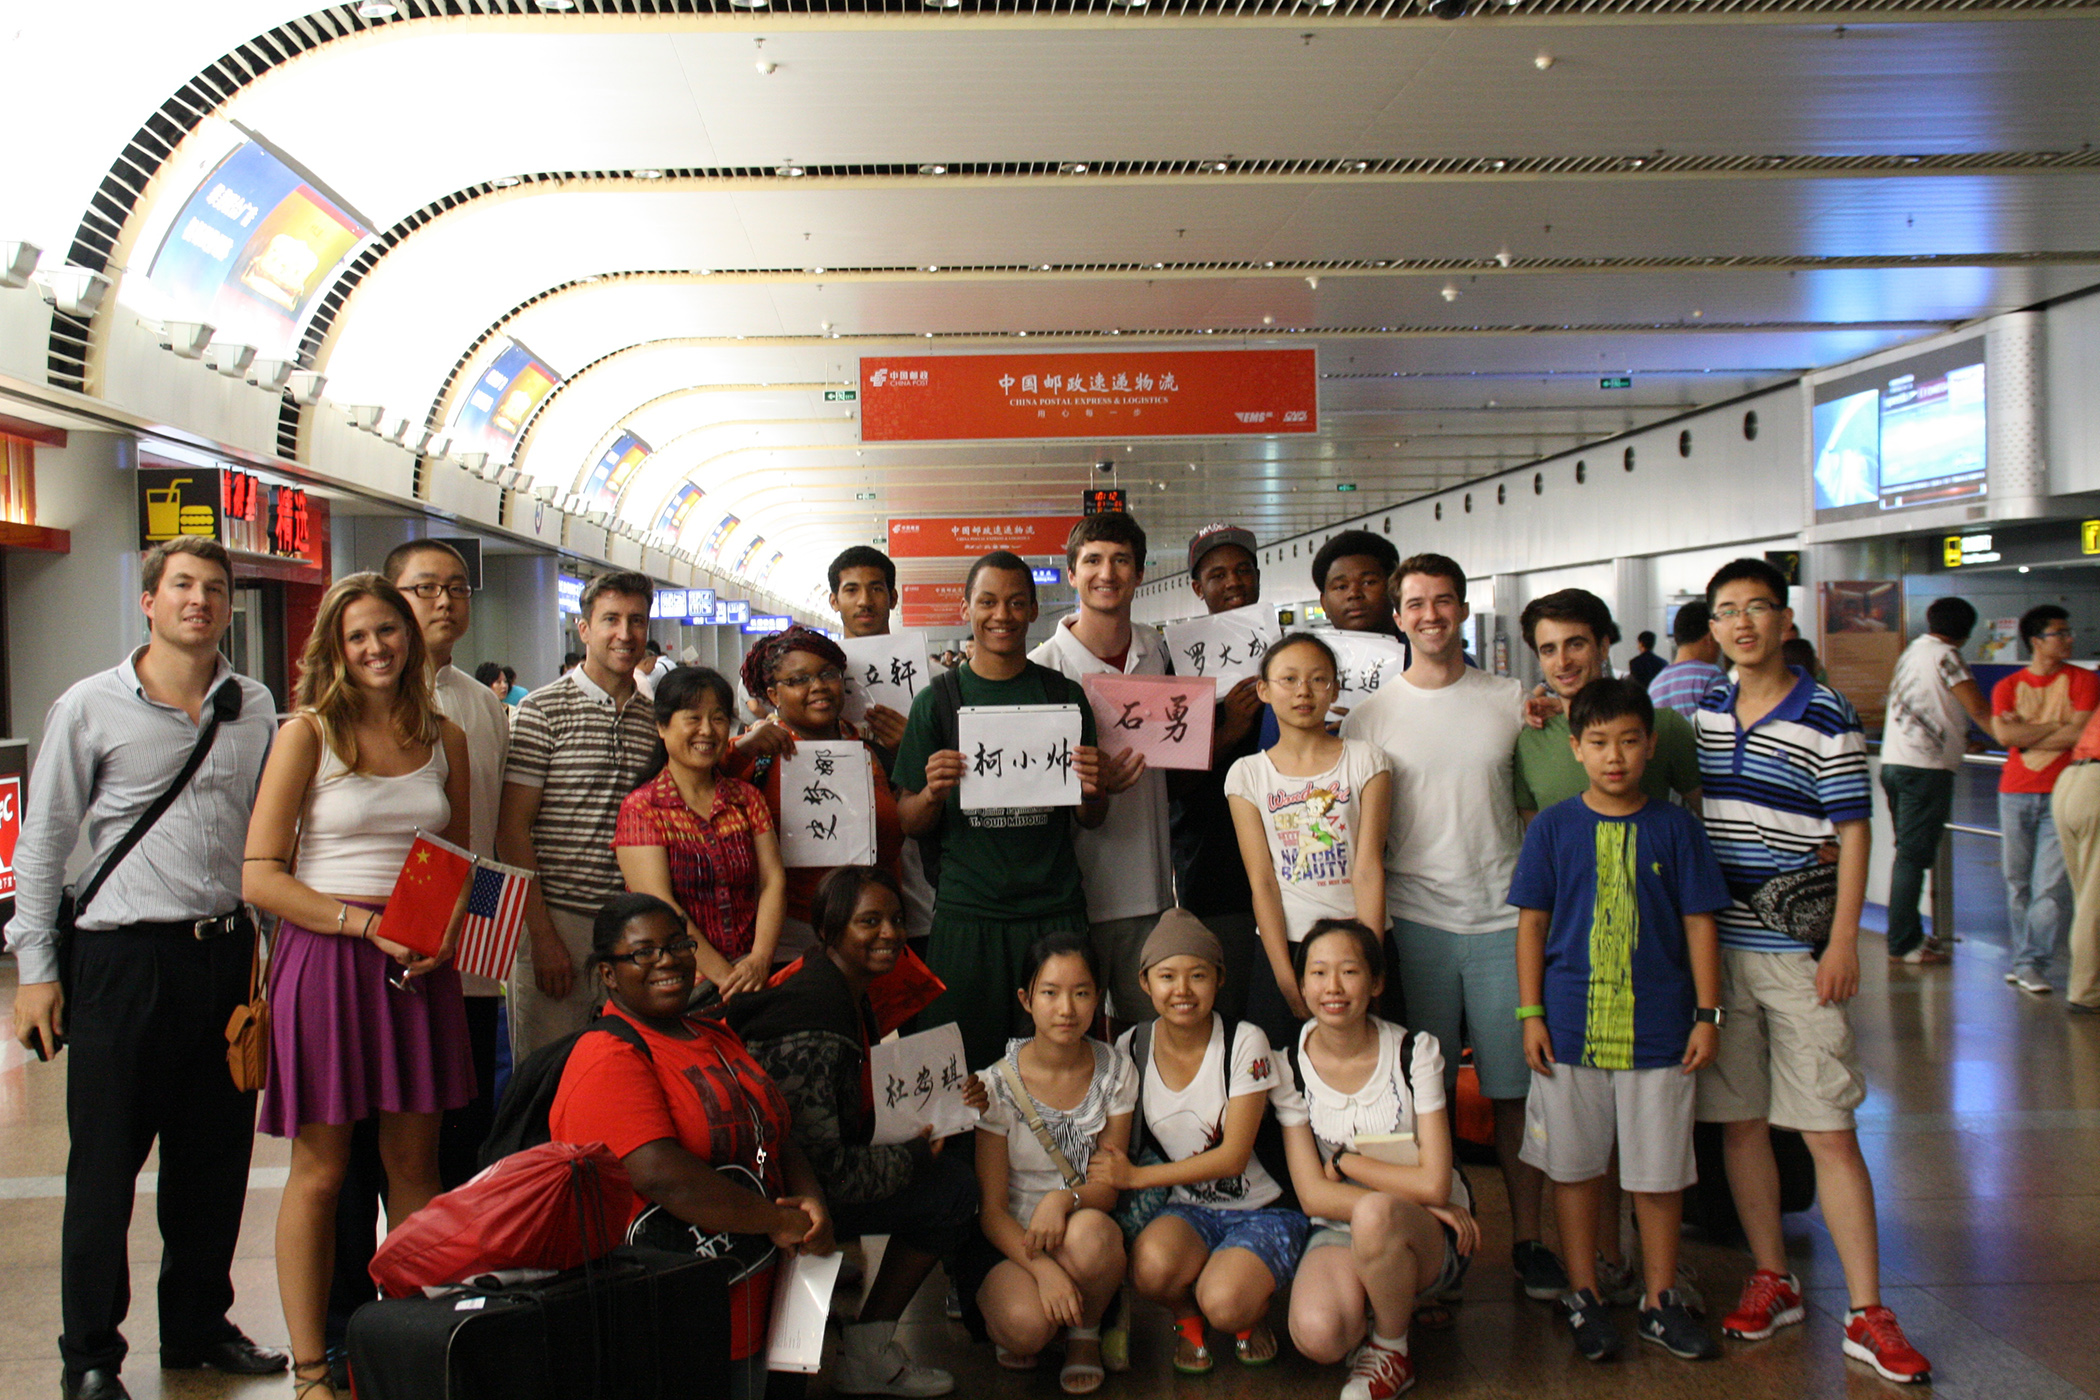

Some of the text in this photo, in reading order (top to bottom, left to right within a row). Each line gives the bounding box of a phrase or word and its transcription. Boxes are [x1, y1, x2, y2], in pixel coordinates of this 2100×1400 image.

[890, 370, 929, 380] 中国邮政
[998, 371, 1179, 396] 中国邮政速递物流
[1009, 396, 1169, 406] CHINA POSTAL EXPRESS & LOGISTICS
[844, 656, 917, 700] 立轩
[1113, 694, 1189, 743] 石勇
[973, 737, 1073, 786] 柯小帅
[1281, 842, 1347, 866] NAURE
[886, 1053, 963, 1112] 杜安琪
